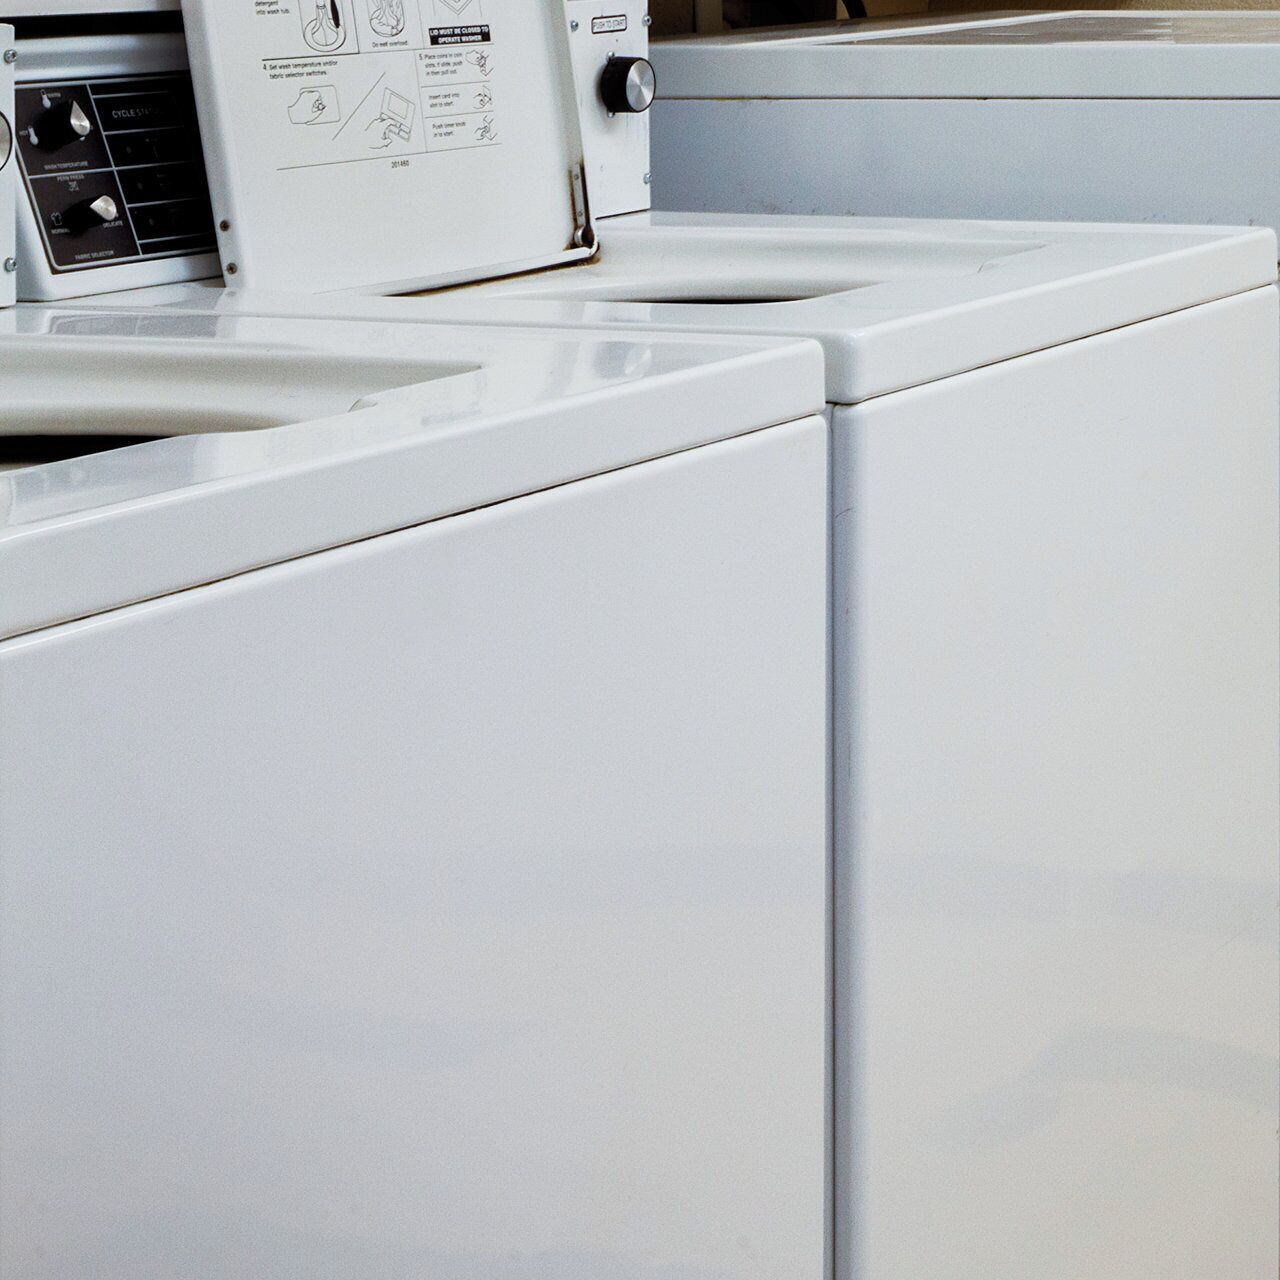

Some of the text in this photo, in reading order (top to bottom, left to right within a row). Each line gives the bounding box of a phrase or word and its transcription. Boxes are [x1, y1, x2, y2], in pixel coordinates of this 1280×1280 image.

[254, 0, 279, 8] detergent
[439, 28, 454, 36] MUST
[461, 26, 481, 35] CLOSED
[481, 25, 489, 33] TO
[269, 71, 304, 80] fabric selector
[112, 109, 135, 119] CYCLE
[70, 173, 84, 181] PRESS
[91, 250, 114, 260] SELECTOR
